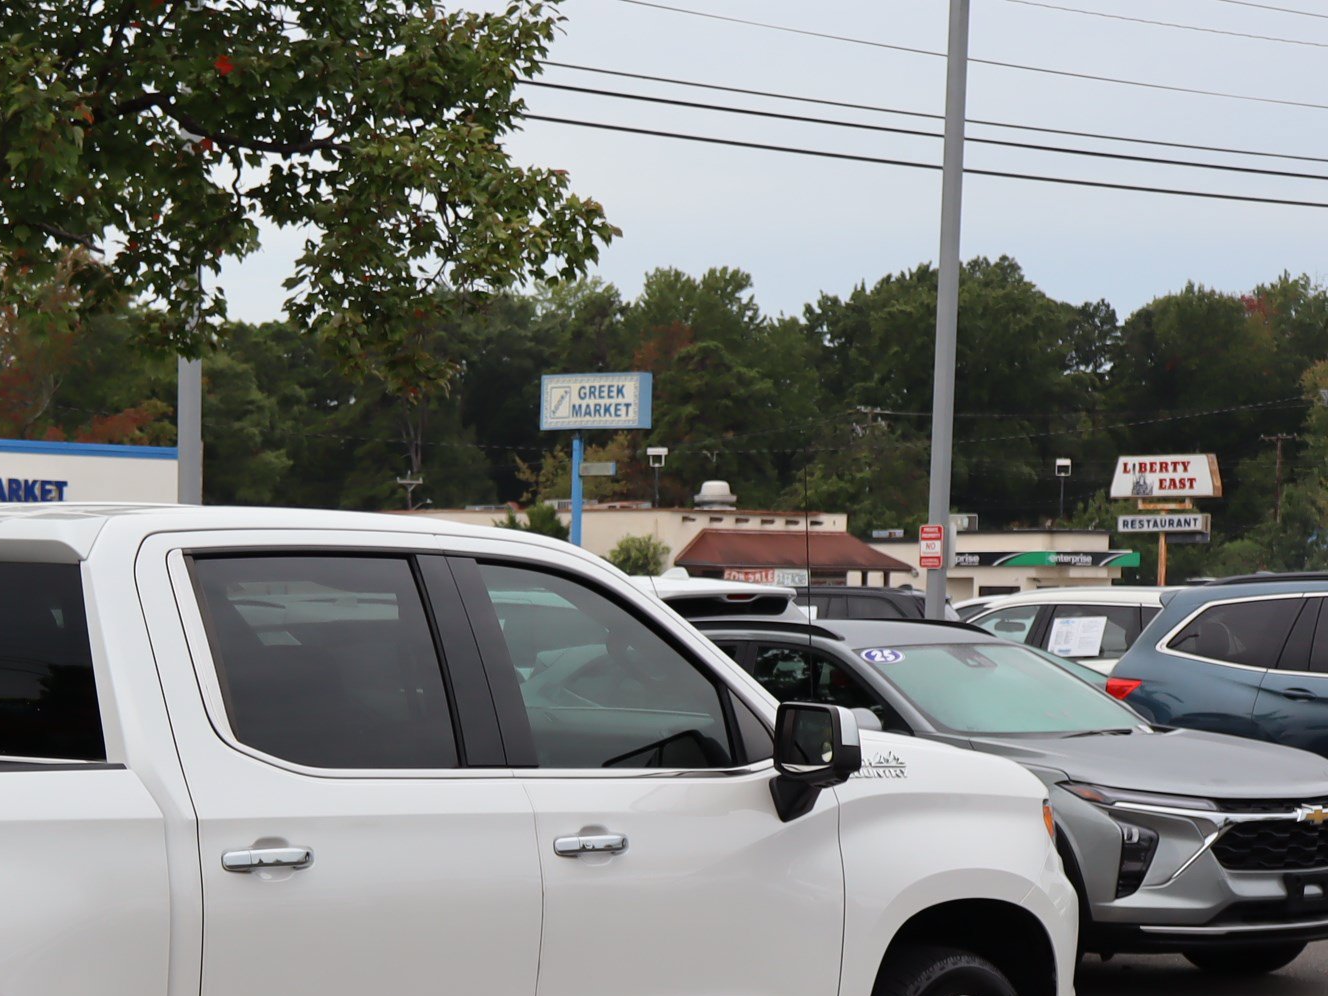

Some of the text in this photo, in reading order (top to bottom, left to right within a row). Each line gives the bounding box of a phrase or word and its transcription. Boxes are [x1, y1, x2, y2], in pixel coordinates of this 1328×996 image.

[578, 385, 625, 400] GREEK
[572, 403, 632, 418] MARKET
[1158, 478, 1196, 490] EAST
[1122, 518, 1198, 529] RESTAURANT
[925, 542, 936, 550] NO
[1048, 553, 1093, 563] enterprise
[871, 649, 896, 662] 25
